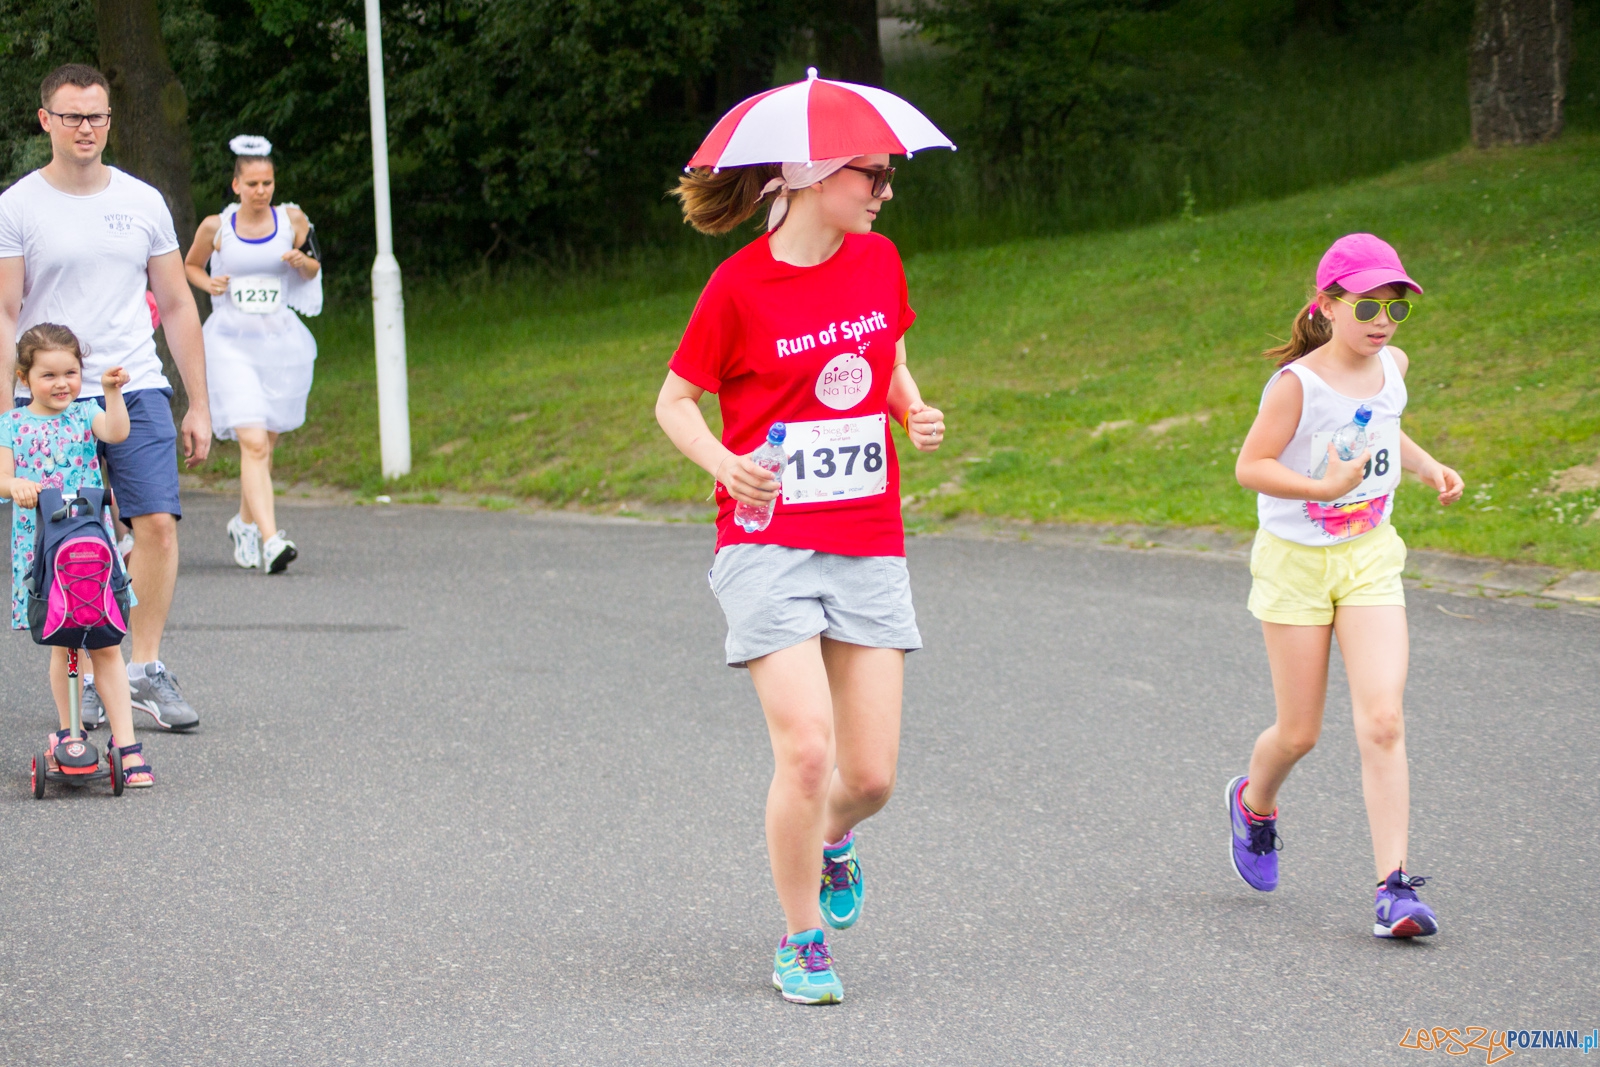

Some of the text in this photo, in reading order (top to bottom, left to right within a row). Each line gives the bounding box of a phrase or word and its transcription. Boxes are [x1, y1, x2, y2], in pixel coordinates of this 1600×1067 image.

[104, 213, 134, 223] NYCITY
[234, 289, 279, 303] 1237
[776, 310, 888, 358] Run of Spirit
[824, 366, 863, 385] Bieg
[822, 384, 862, 397] Na Tak
[787, 442, 883, 480] 1378
